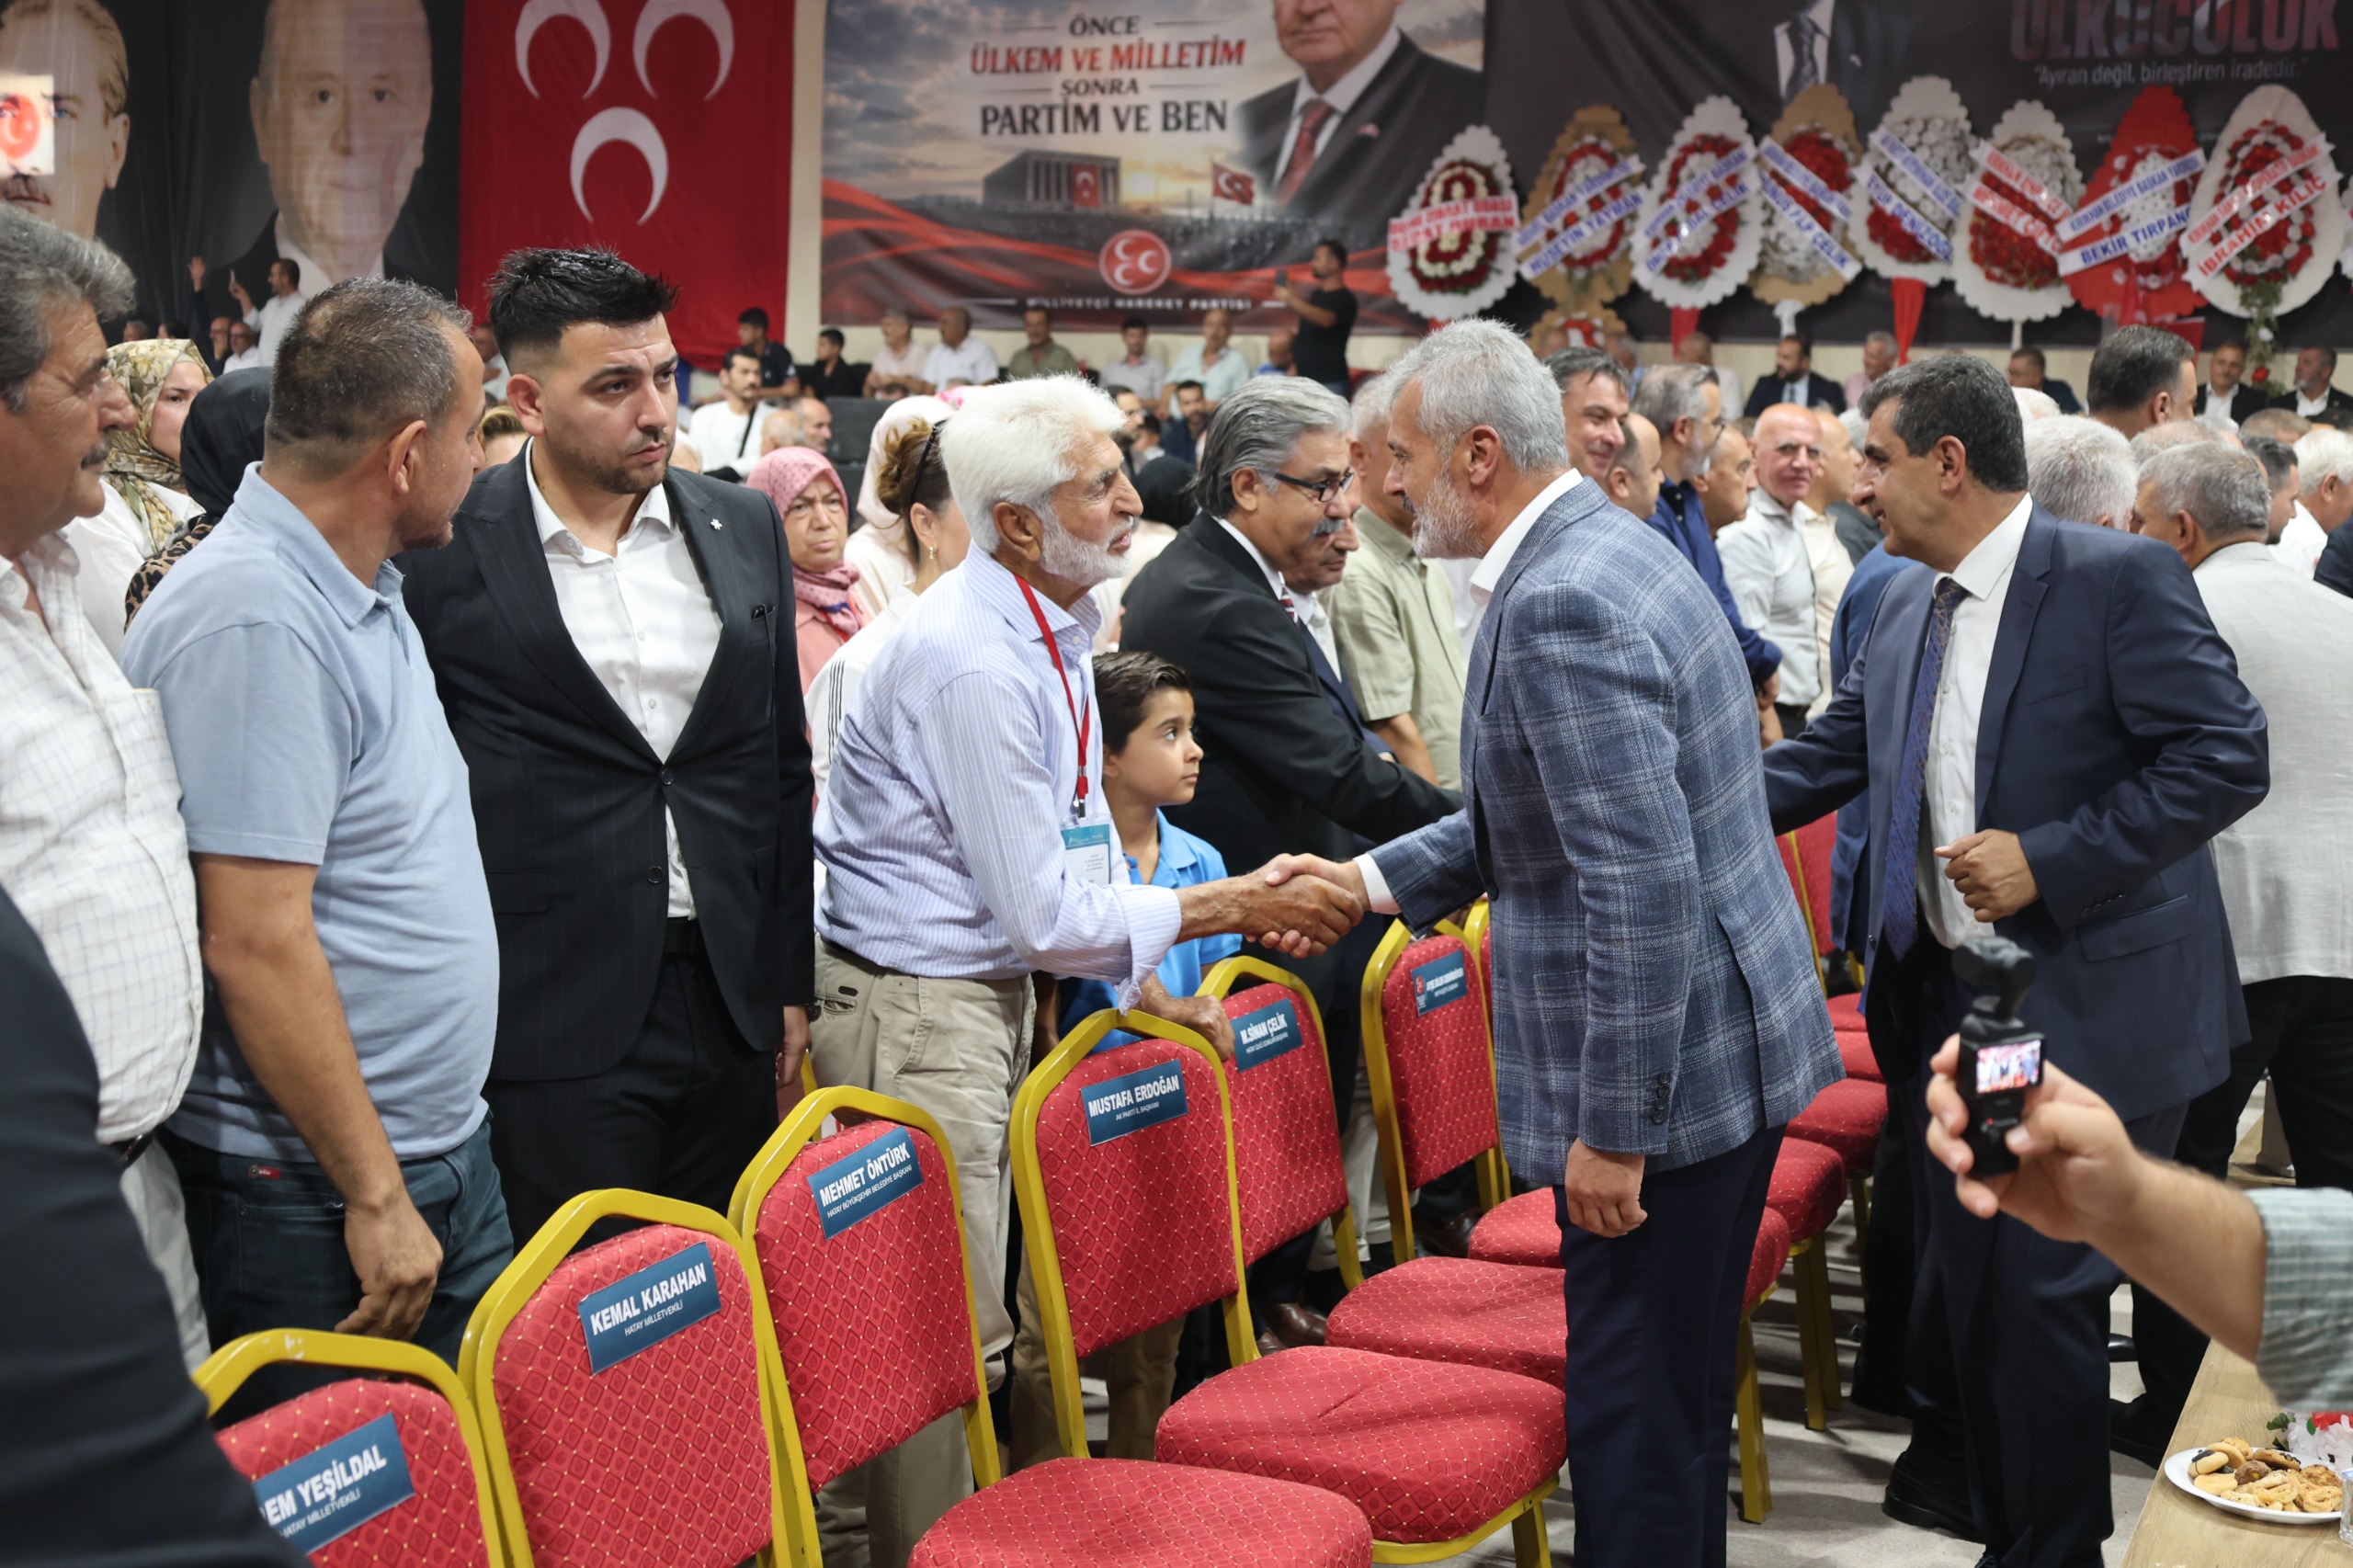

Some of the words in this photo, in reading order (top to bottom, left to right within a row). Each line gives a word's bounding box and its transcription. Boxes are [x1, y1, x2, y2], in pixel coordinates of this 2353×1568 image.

[1069, 14, 1140, 36] ÖNCE
[970, 41, 1063, 74] ÜLKEM
[1071, 46, 1102, 73] VE
[1109, 35, 1246, 71] MİLLETİM
[1060, 77, 1140, 97] SONRA
[981, 97, 1100, 135] PARTİM
[1112, 104, 1151, 132] VE
[1161, 99, 1228, 131] BEN
[2080, 235, 2130, 266] BEKİR
[1088, 1089, 1134, 1118] MUSTAFA
[1134, 1074, 1180, 1103] ERDOĞAN
[1122, 1108, 1136, 1119] PARTİ
[1140, 1101, 1160, 1112] BAŞKANI
[819, 1166, 866, 1208] MEHMET
[866, 1142, 911, 1180] ÖNTÜRK
[826, 1205, 843, 1219] HATAY
[842, 1187, 872, 1210] BÜYÜKŞEHİR
[871, 1176, 893, 1196] BELEDİYE
[892, 1164, 913, 1181] BAŞKANI
[590, 1295, 641, 1336] KEMAL
[641, 1262, 707, 1312] KARAHAN
[624, 1321, 643, 1336] HATAY
[643, 1300, 684, 1326] MİLLETVEKİLİ
[296, 1444, 387, 1507] YEŞİLDAL
[307, 1487, 361, 1526] MİLLETVEKİLİ
